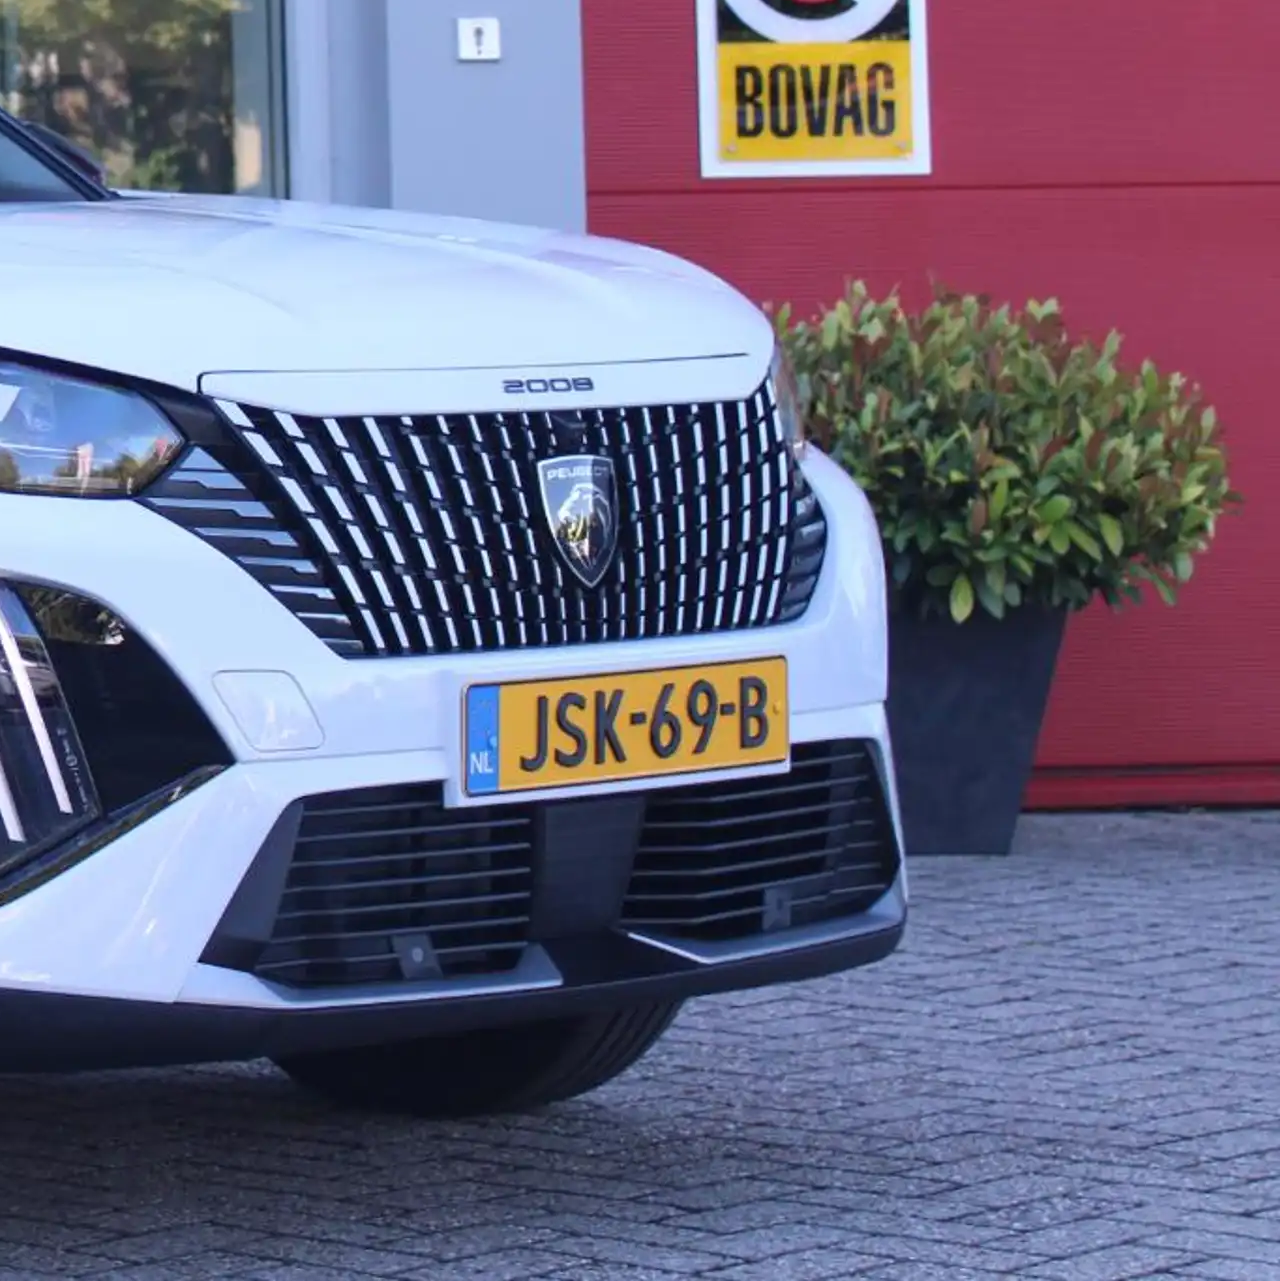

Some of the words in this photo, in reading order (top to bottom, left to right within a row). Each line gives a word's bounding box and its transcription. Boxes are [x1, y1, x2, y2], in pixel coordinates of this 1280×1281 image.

[734, 61, 896, 140] BOVAG
[502, 377, 594, 393] 2008
[519, 675, 769, 773] JSK-69-B
[470, 751, 493, 774] NL
